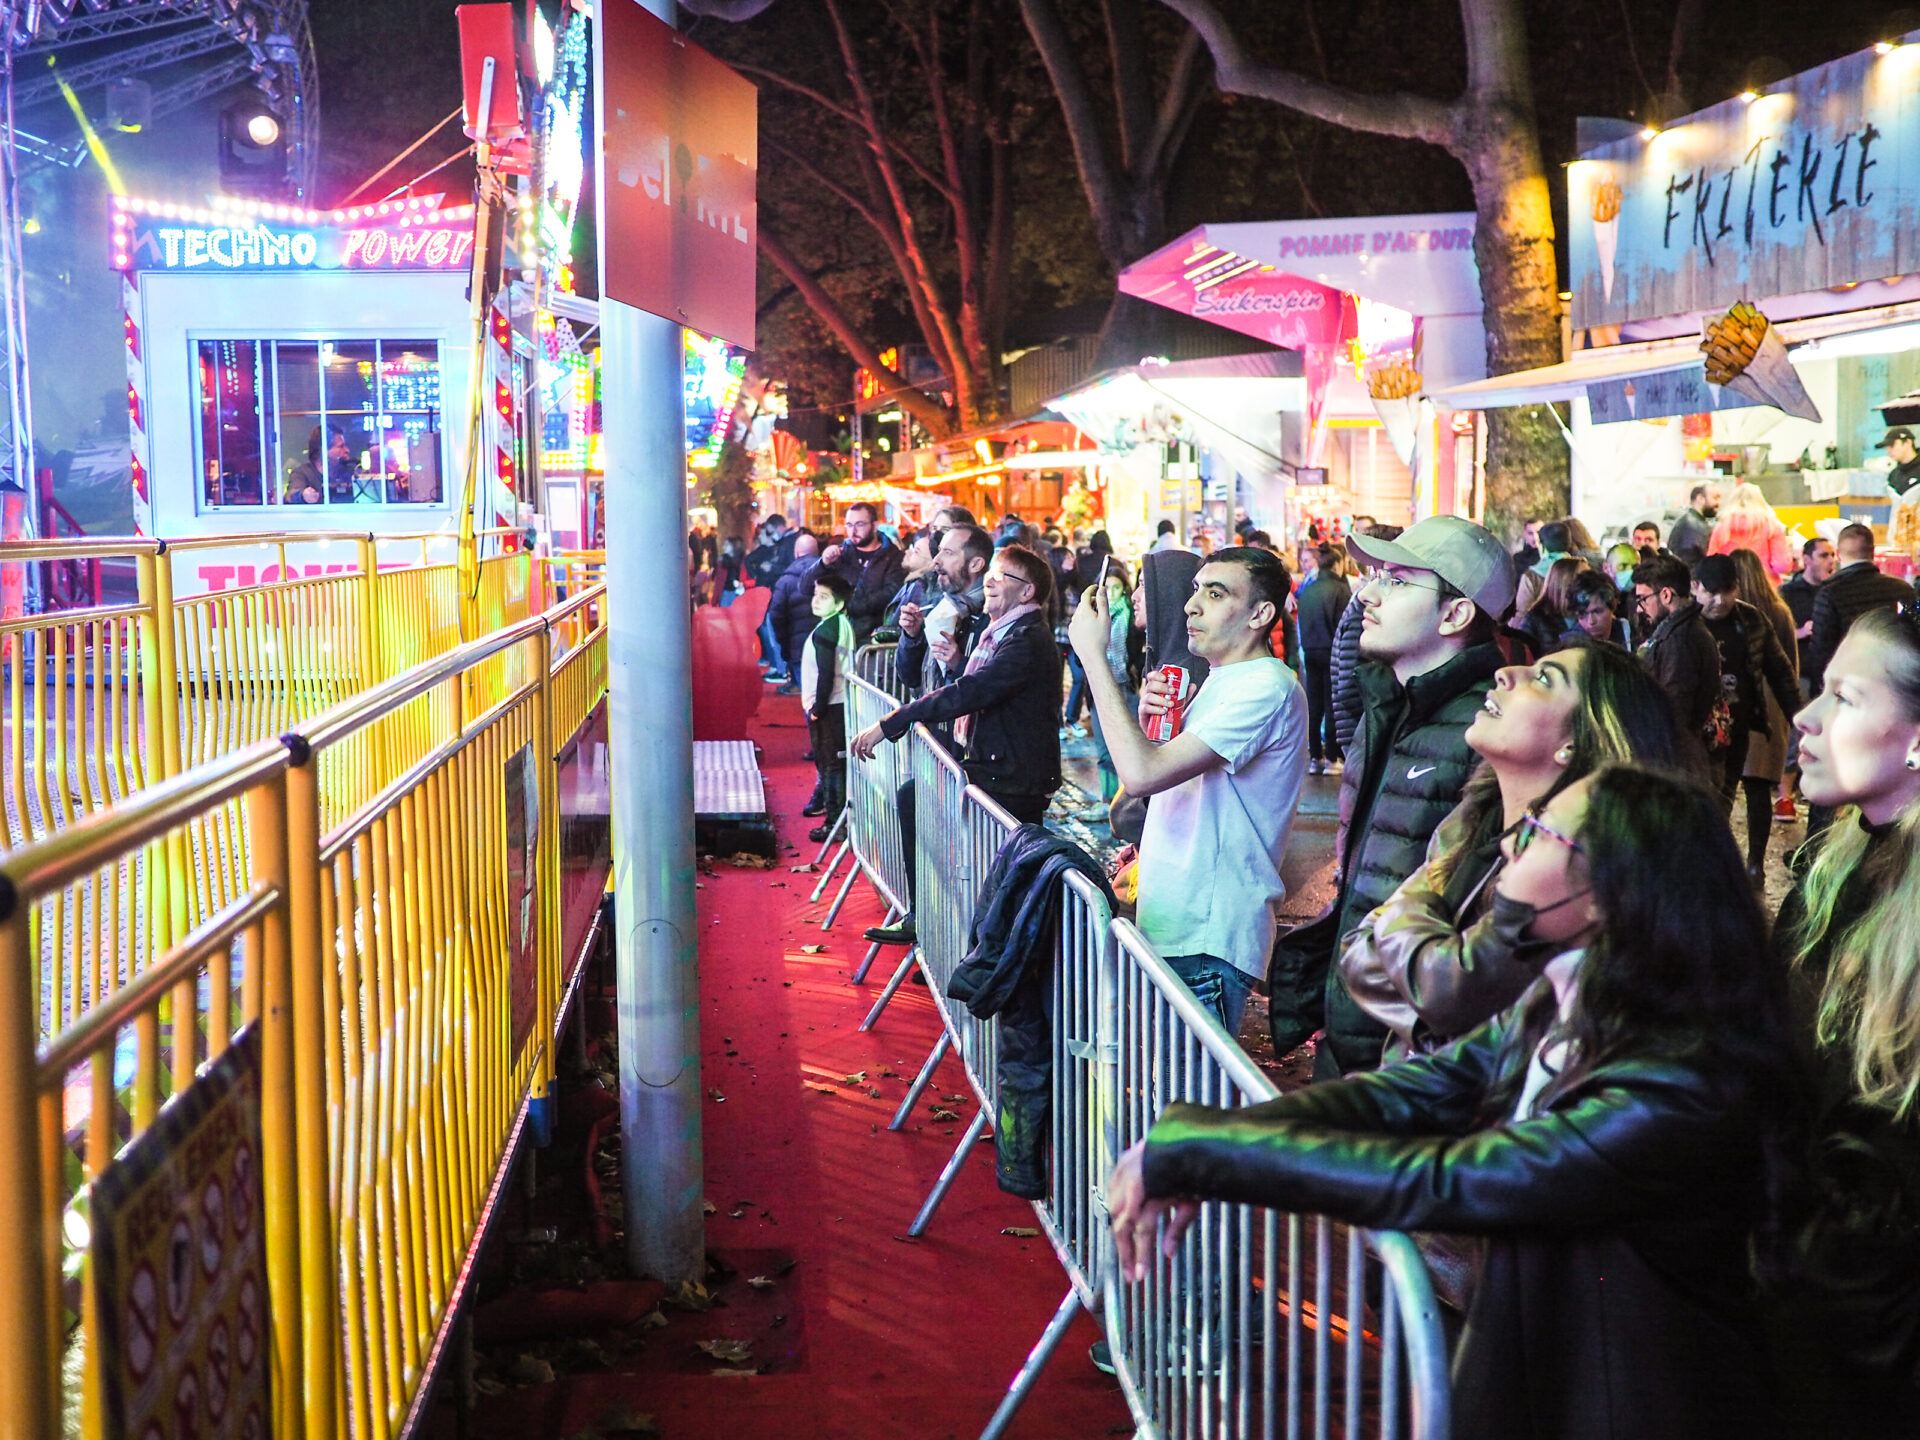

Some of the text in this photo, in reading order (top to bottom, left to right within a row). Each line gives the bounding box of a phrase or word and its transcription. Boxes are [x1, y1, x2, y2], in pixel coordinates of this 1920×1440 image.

[1664, 123, 1880, 267] FRITERIE
[159, 224, 317, 267] TECHNO
[1280, 231, 1365, 258] POMME
[1193, 288, 1324, 316] Suikerspin
